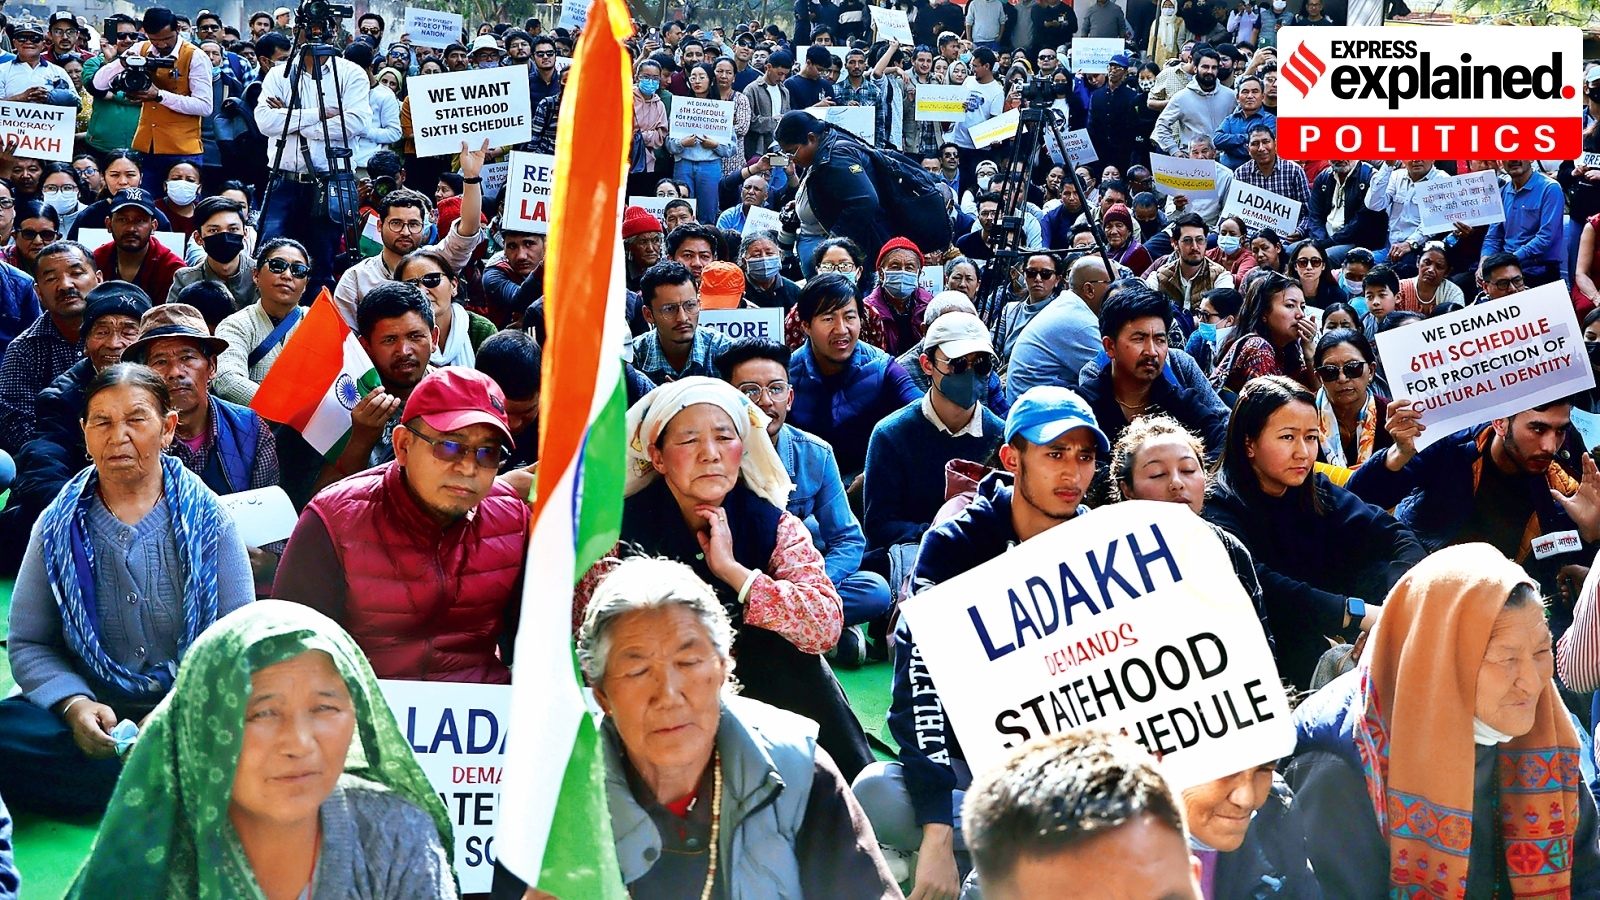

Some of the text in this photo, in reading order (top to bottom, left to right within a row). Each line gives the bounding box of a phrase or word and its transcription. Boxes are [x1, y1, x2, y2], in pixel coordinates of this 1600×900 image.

[414, 21, 430, 29] PRIDE
[421, 30, 445, 38] NATION
[427, 81, 511, 103] WE WANT
[0, 106, 64, 121] E WANT
[435, 102, 509, 121] STATEHOOD
[687, 115, 719, 123] PROTECTION
[692, 108, 725, 117] SCHEDULE
[0, 119, 55, 131] MOCRACY
[420, 115, 525, 138] SIXTH SCHEDULE
[675, 121, 702, 129] CULTURAL
[520, 199, 549, 222] LA
[1237, 190, 1291, 220] LADAKH
[1242, 208, 1278, 225] DEMANDS
[1421, 305, 1521, 343] WE DEMAND
[1410, 318, 1550, 372] 6TH SCHEDULE
[1406, 337, 1566, 395] FOR PROTECTION OF
[1412, 354, 1571, 413] CULTURAL IDENTITY
[967, 523, 1183, 662] LADAKH
[1044, 622, 1139, 676] DEMANDS
[995, 631, 1228, 749] STATEHOOD
[407, 706, 508, 754] LAD
[439, 792, 500, 826] TE
